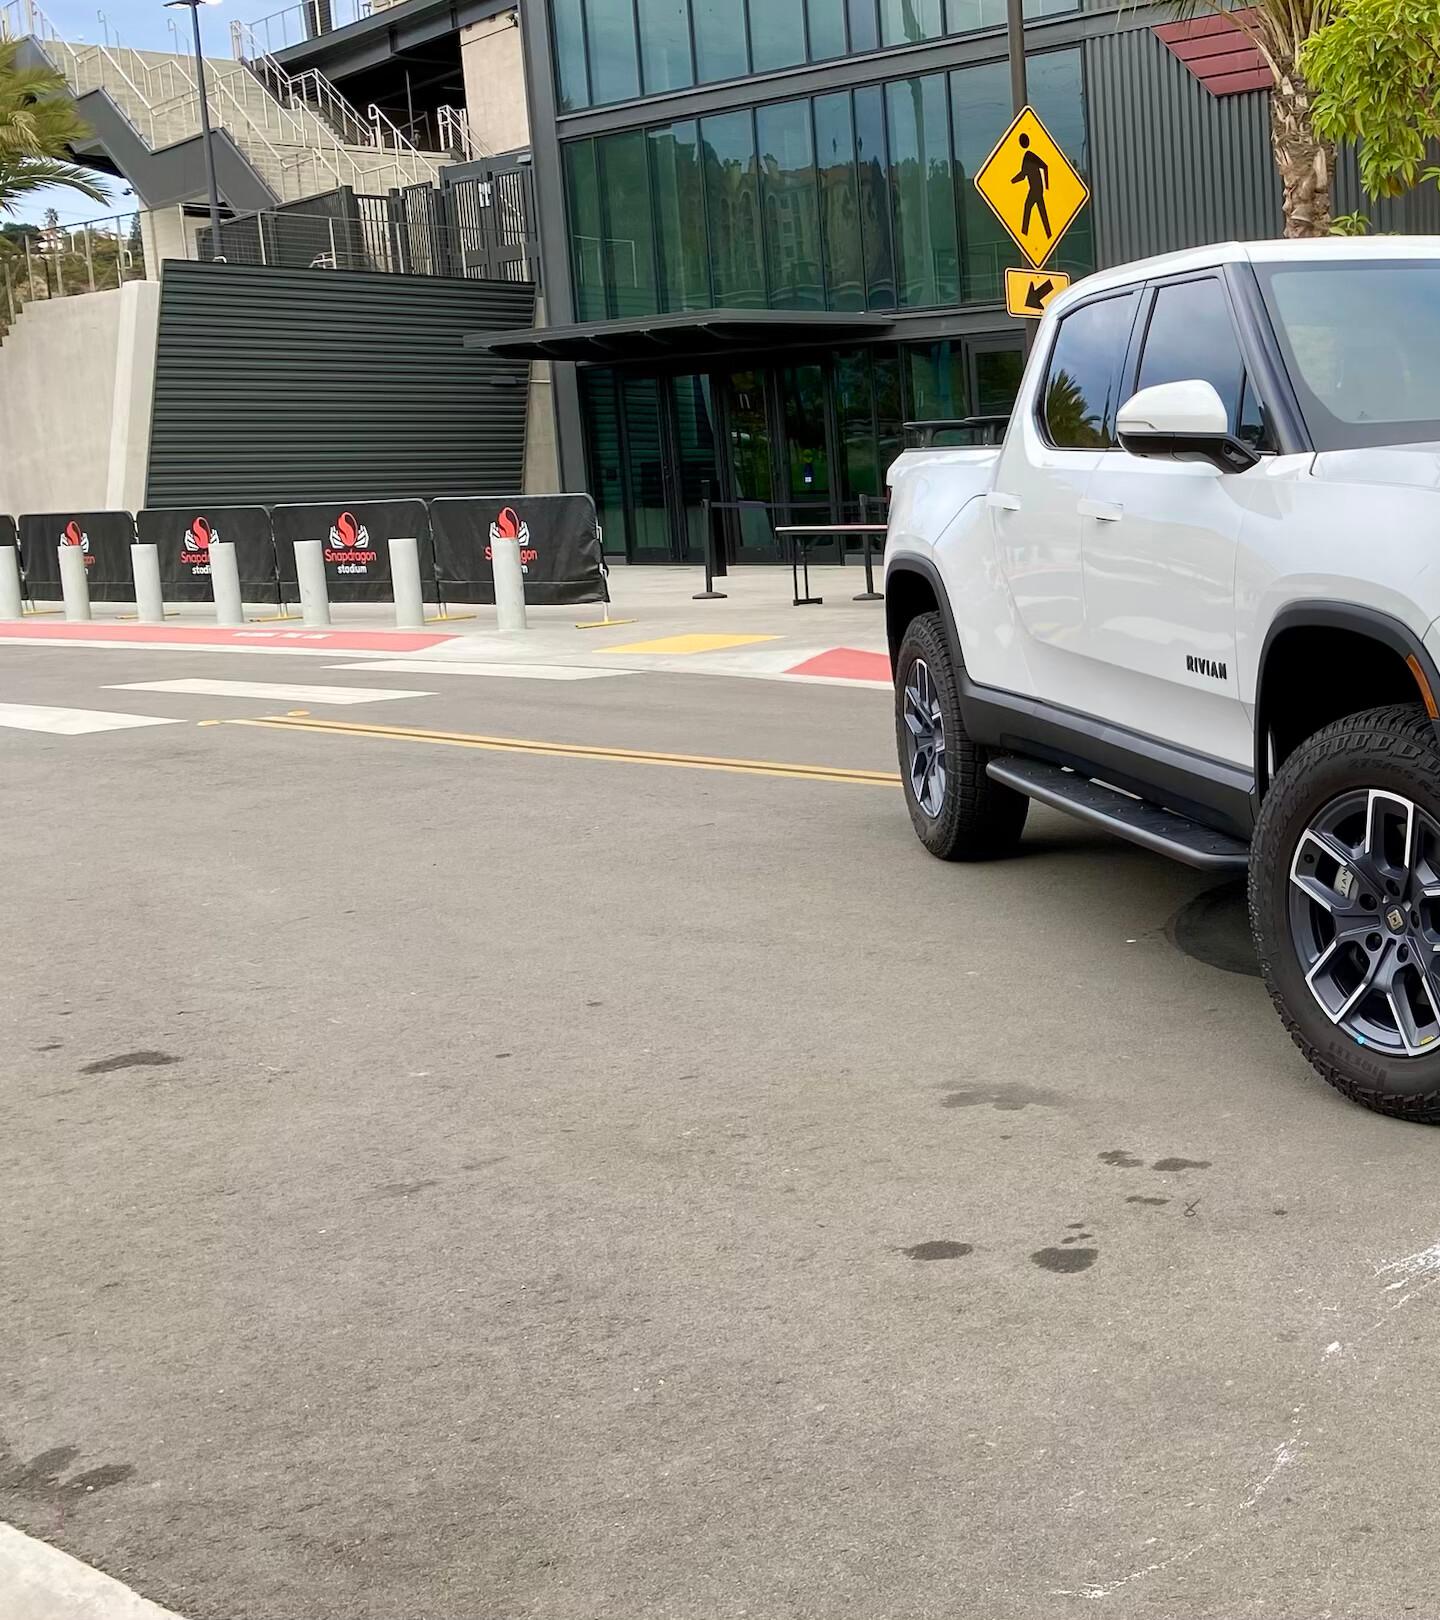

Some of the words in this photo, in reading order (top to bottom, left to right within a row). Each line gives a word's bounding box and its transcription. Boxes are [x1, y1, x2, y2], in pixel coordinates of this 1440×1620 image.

[181, 551, 209, 566] Snapd
[325, 548, 377, 565] Snapdragon
[192, 564, 211, 575] stadi
[337, 563, 368, 574] stadium
[1186, 654, 1227, 680] RIVIAN
